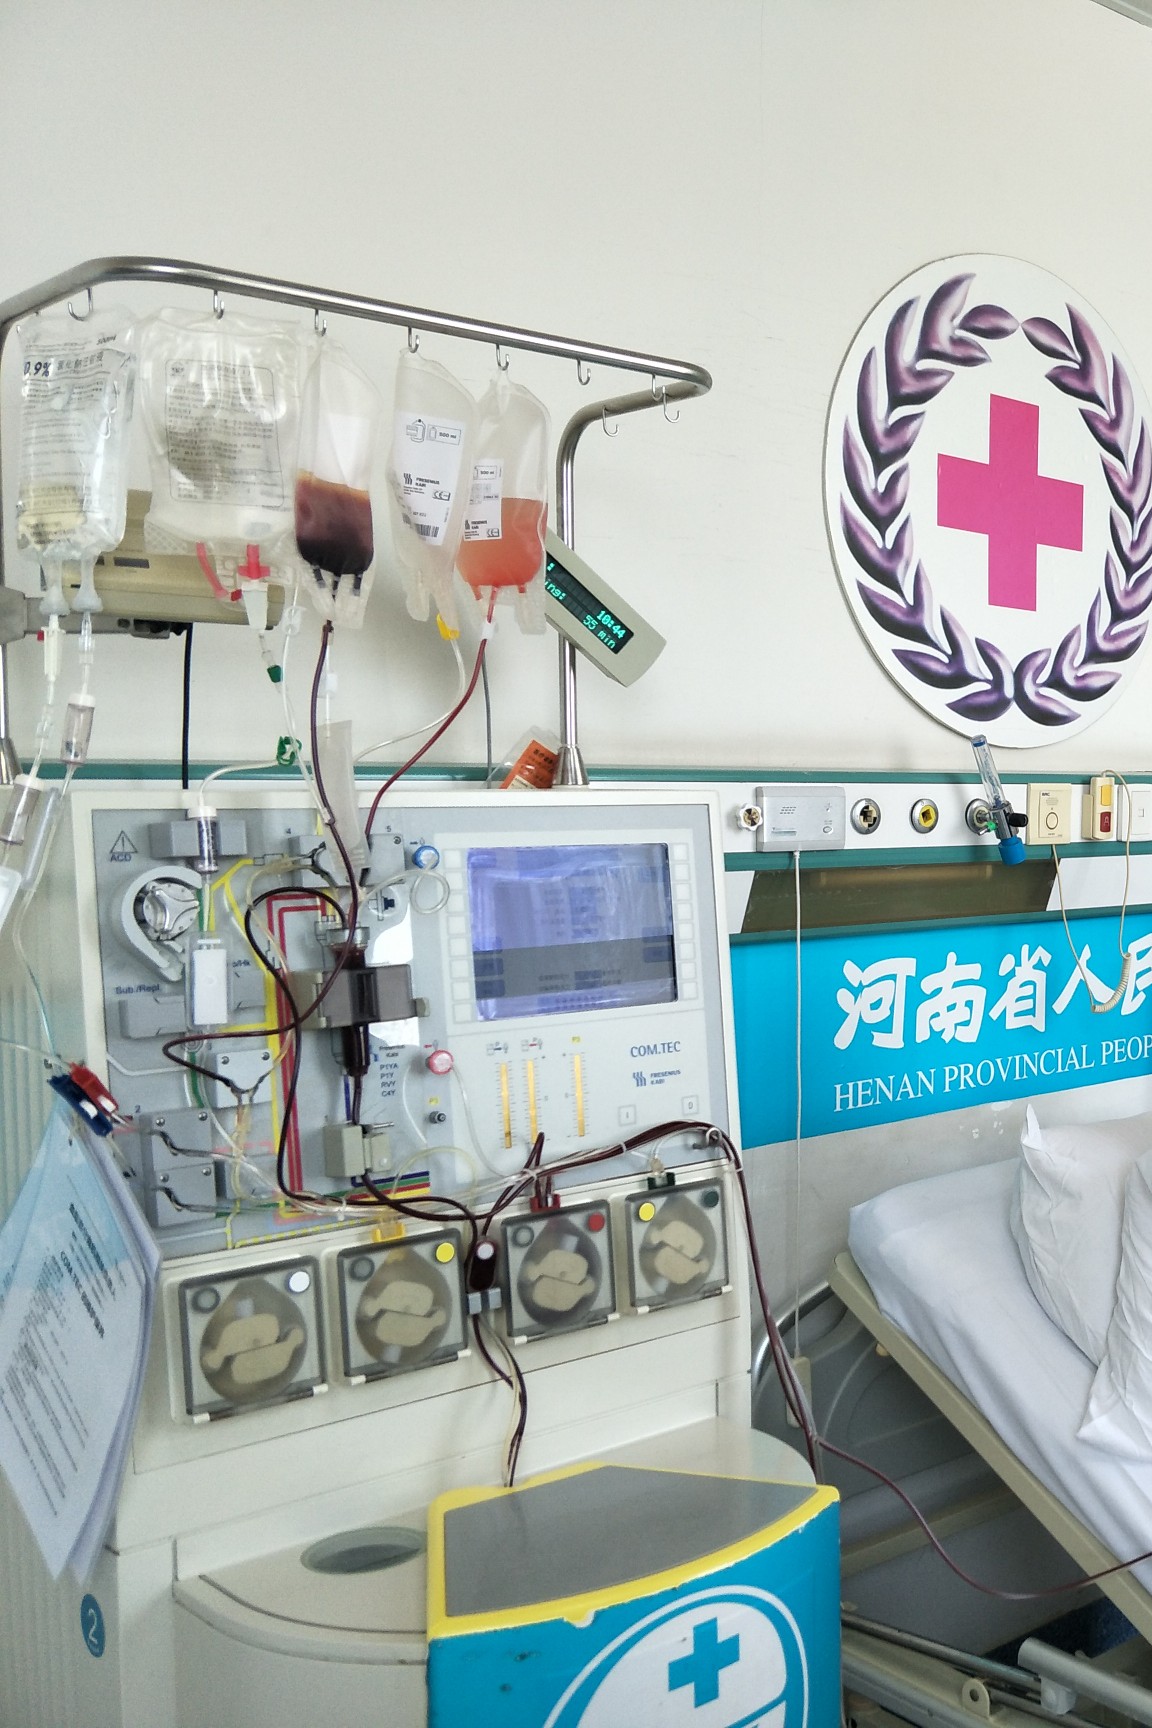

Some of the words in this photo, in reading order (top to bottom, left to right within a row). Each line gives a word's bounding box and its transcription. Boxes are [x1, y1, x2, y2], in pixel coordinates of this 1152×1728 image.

[582, 614, 599, 630] 55
[597, 630, 616, 649] min
[596, 610, 626, 639] 10:44
[110, 852, 132, 862] ACD
[630, 1041, 681, 1058] COM.TEC
[650, 1069, 682, 1078] FRESENIUS
[834, 1068, 936, 1112] HENAN
[943, 1044, 1095, 1093] PROVINCIAL
